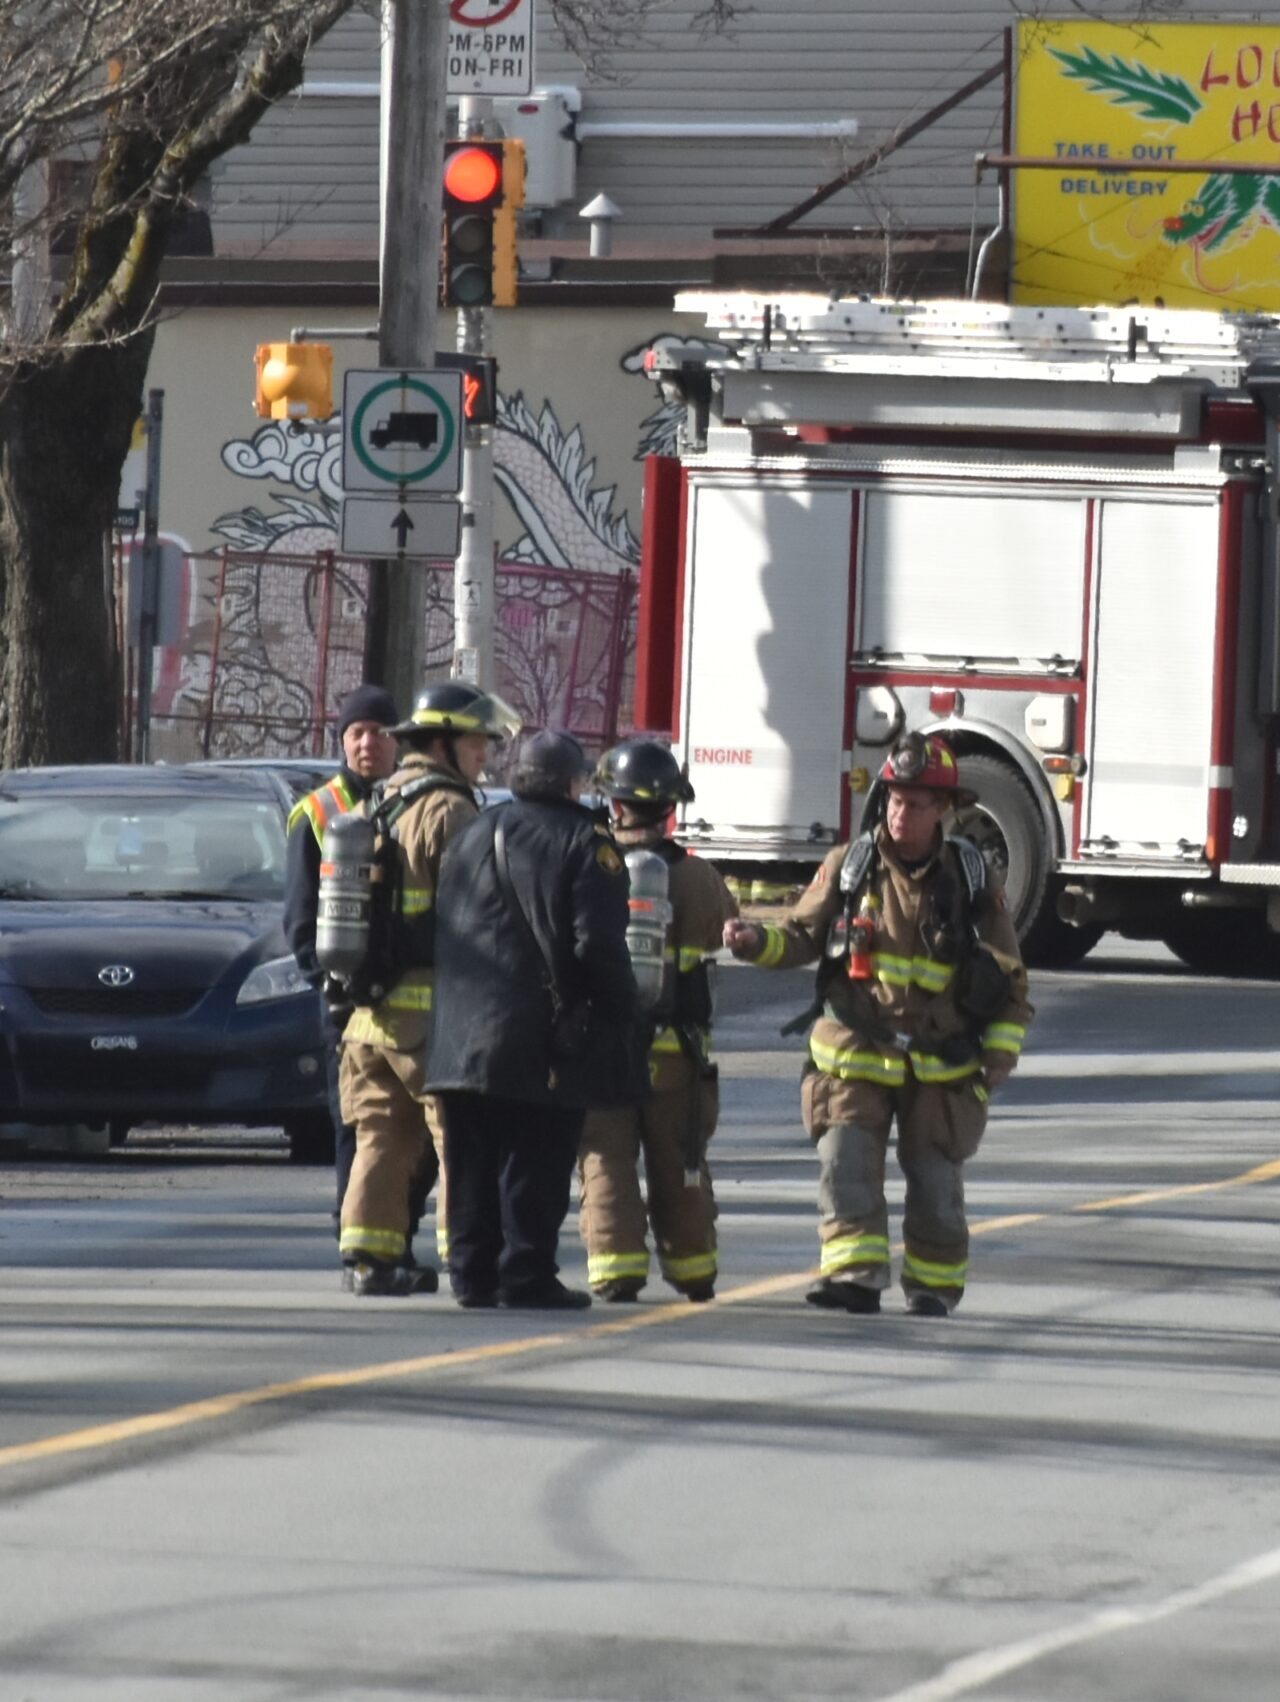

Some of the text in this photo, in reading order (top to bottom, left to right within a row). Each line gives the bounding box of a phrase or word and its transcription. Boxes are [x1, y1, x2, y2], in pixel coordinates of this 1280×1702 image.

[450, 57, 522, 77] ON-FRI
[1054, 142, 1110, 158] TAKE
[1131, 143, 1177, 160] OUT
[1061, 179, 1168, 195] DELIVERY
[694, 748, 753, 764] ENGINE
